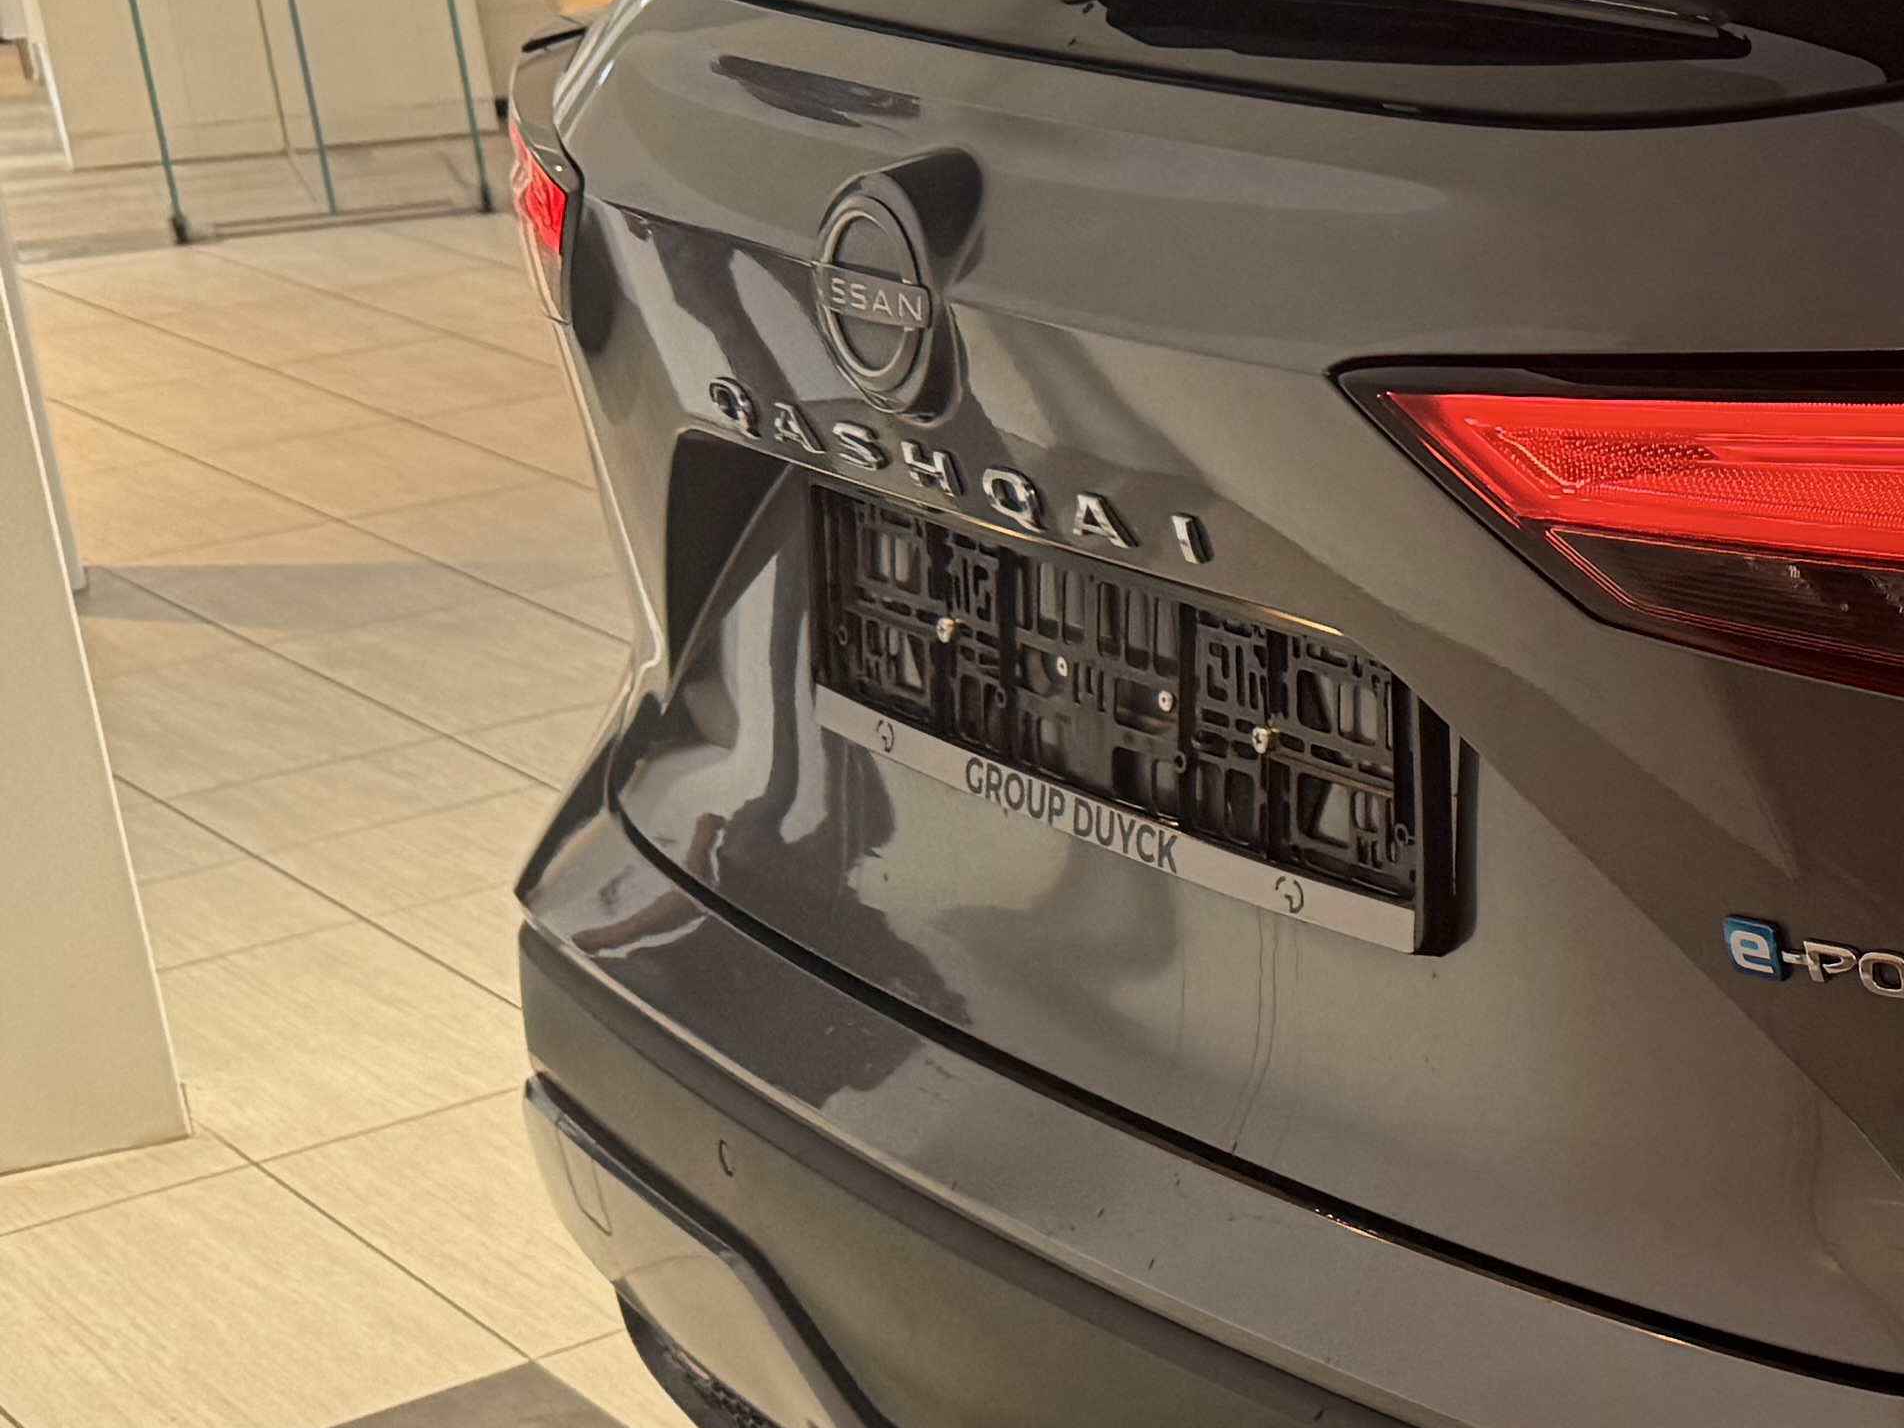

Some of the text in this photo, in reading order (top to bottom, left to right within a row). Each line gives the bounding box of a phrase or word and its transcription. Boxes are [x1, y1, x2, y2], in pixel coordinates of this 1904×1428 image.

[831, 277, 923, 322] SSAN
[709, 376, 1212, 565] QASHQAI
[965, 756, 1179, 874] GROUP DUYCK
